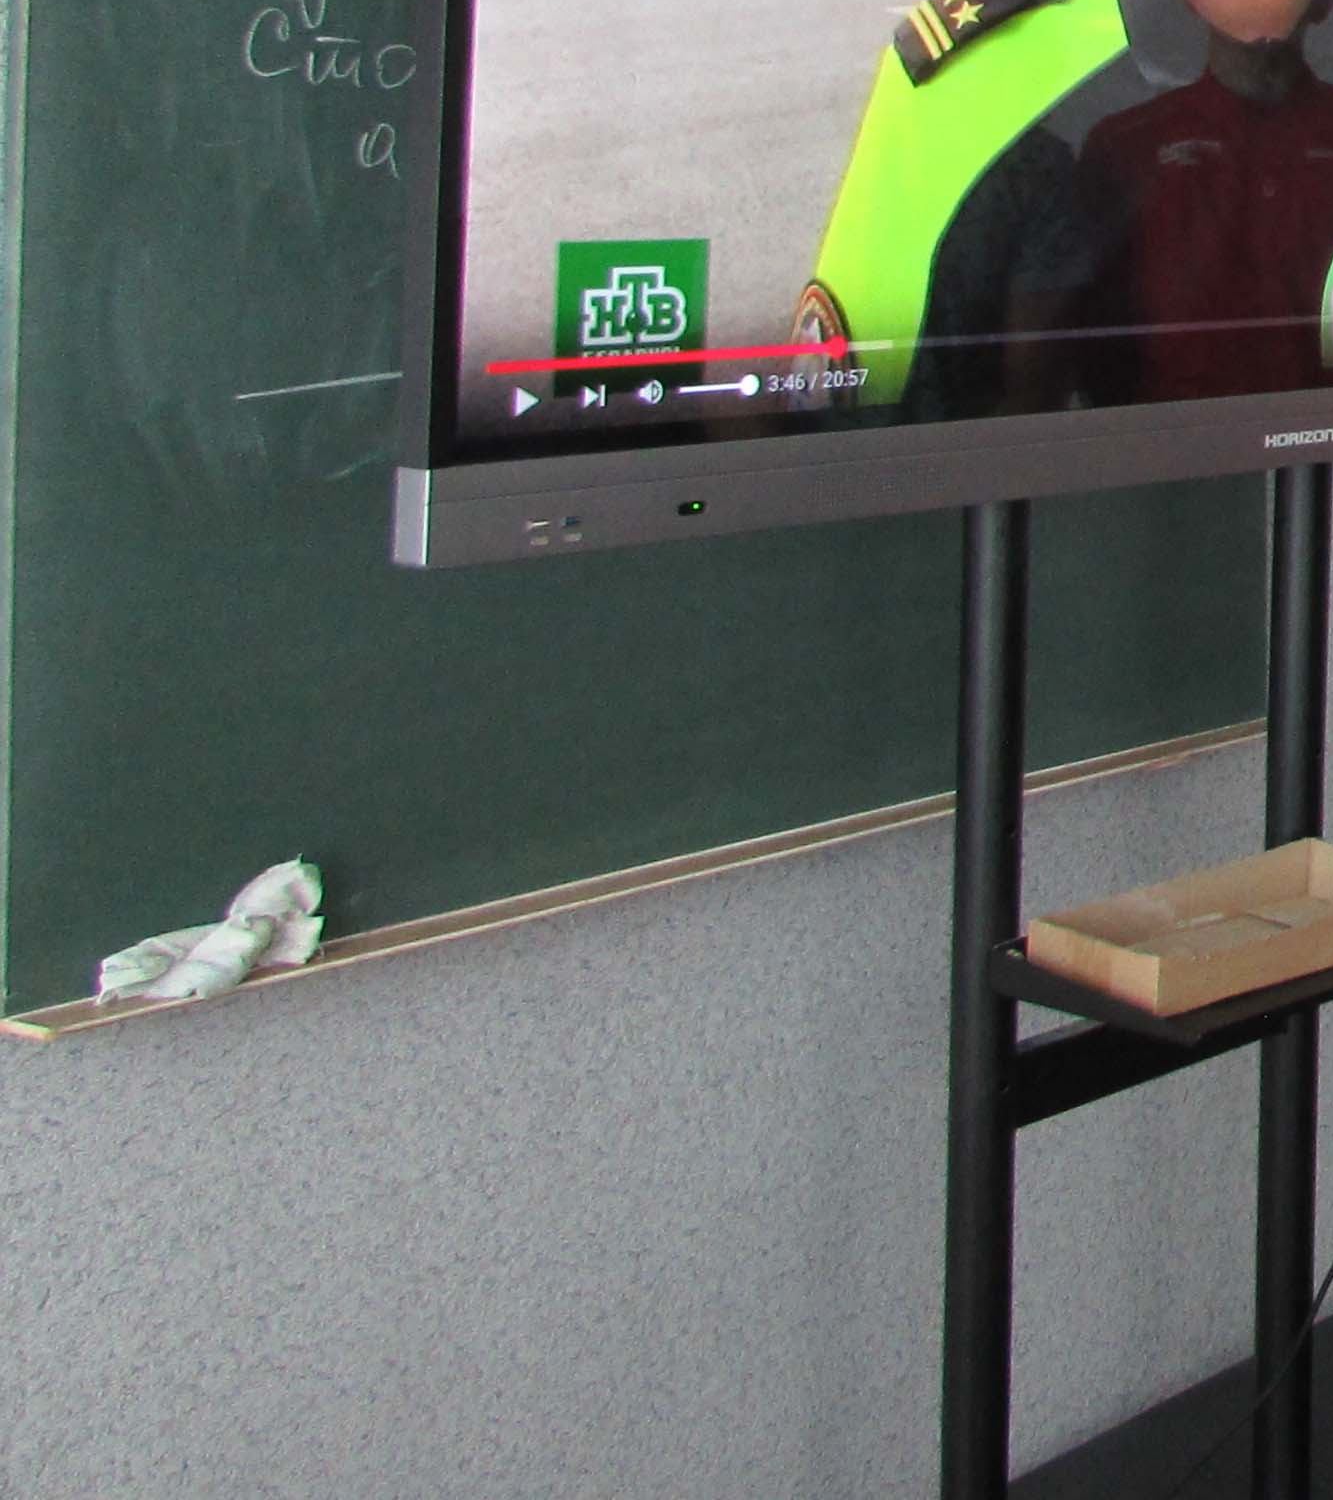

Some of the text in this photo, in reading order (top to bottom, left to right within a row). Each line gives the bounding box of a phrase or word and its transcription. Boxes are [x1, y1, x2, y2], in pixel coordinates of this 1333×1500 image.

[583, 266, 687, 346] НТВ
[767, 373, 806, 393] 3:46
[823, 368, 869, 389] 20:57
